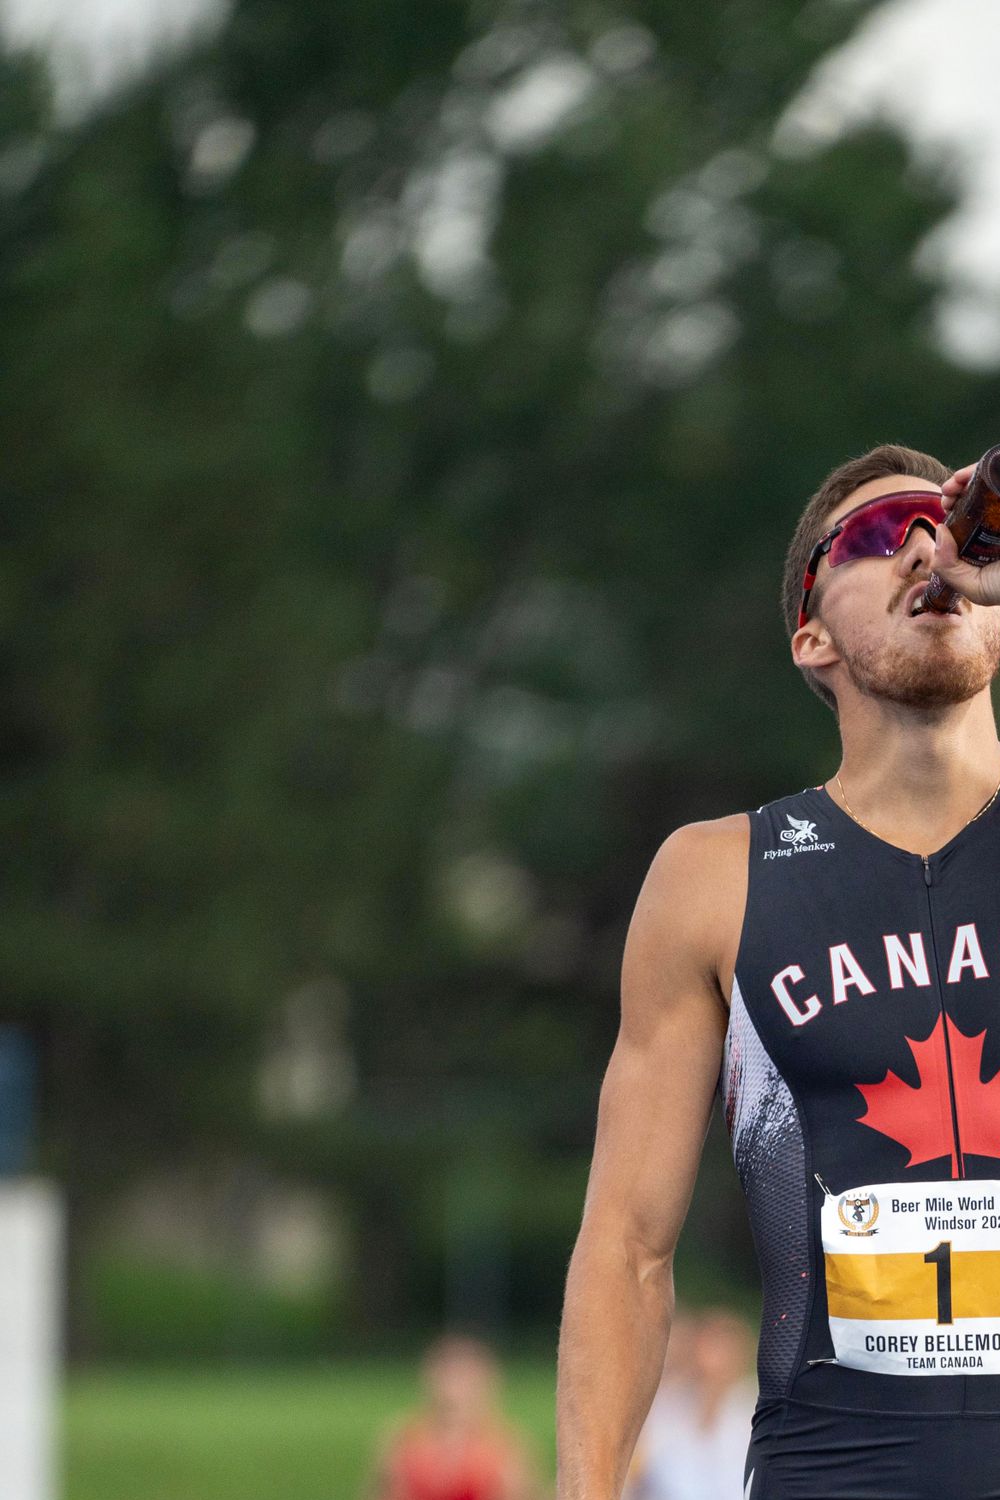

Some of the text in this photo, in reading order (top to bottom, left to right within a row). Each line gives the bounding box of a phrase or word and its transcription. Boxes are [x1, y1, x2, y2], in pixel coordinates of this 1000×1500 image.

[763, 842, 835, 860] Flying Monkeys
[891, 1199, 920, 1213] Beer
[925, 1198, 953, 1212] Mile
[957, 1196, 995, 1211] World
[924, 1216, 977, 1230] Windsor
[924, 1240, 954, 1325] 1
[865, 1335, 918, 1353] COREY
[906, 1356, 983, 1369] TEAM CANADA
